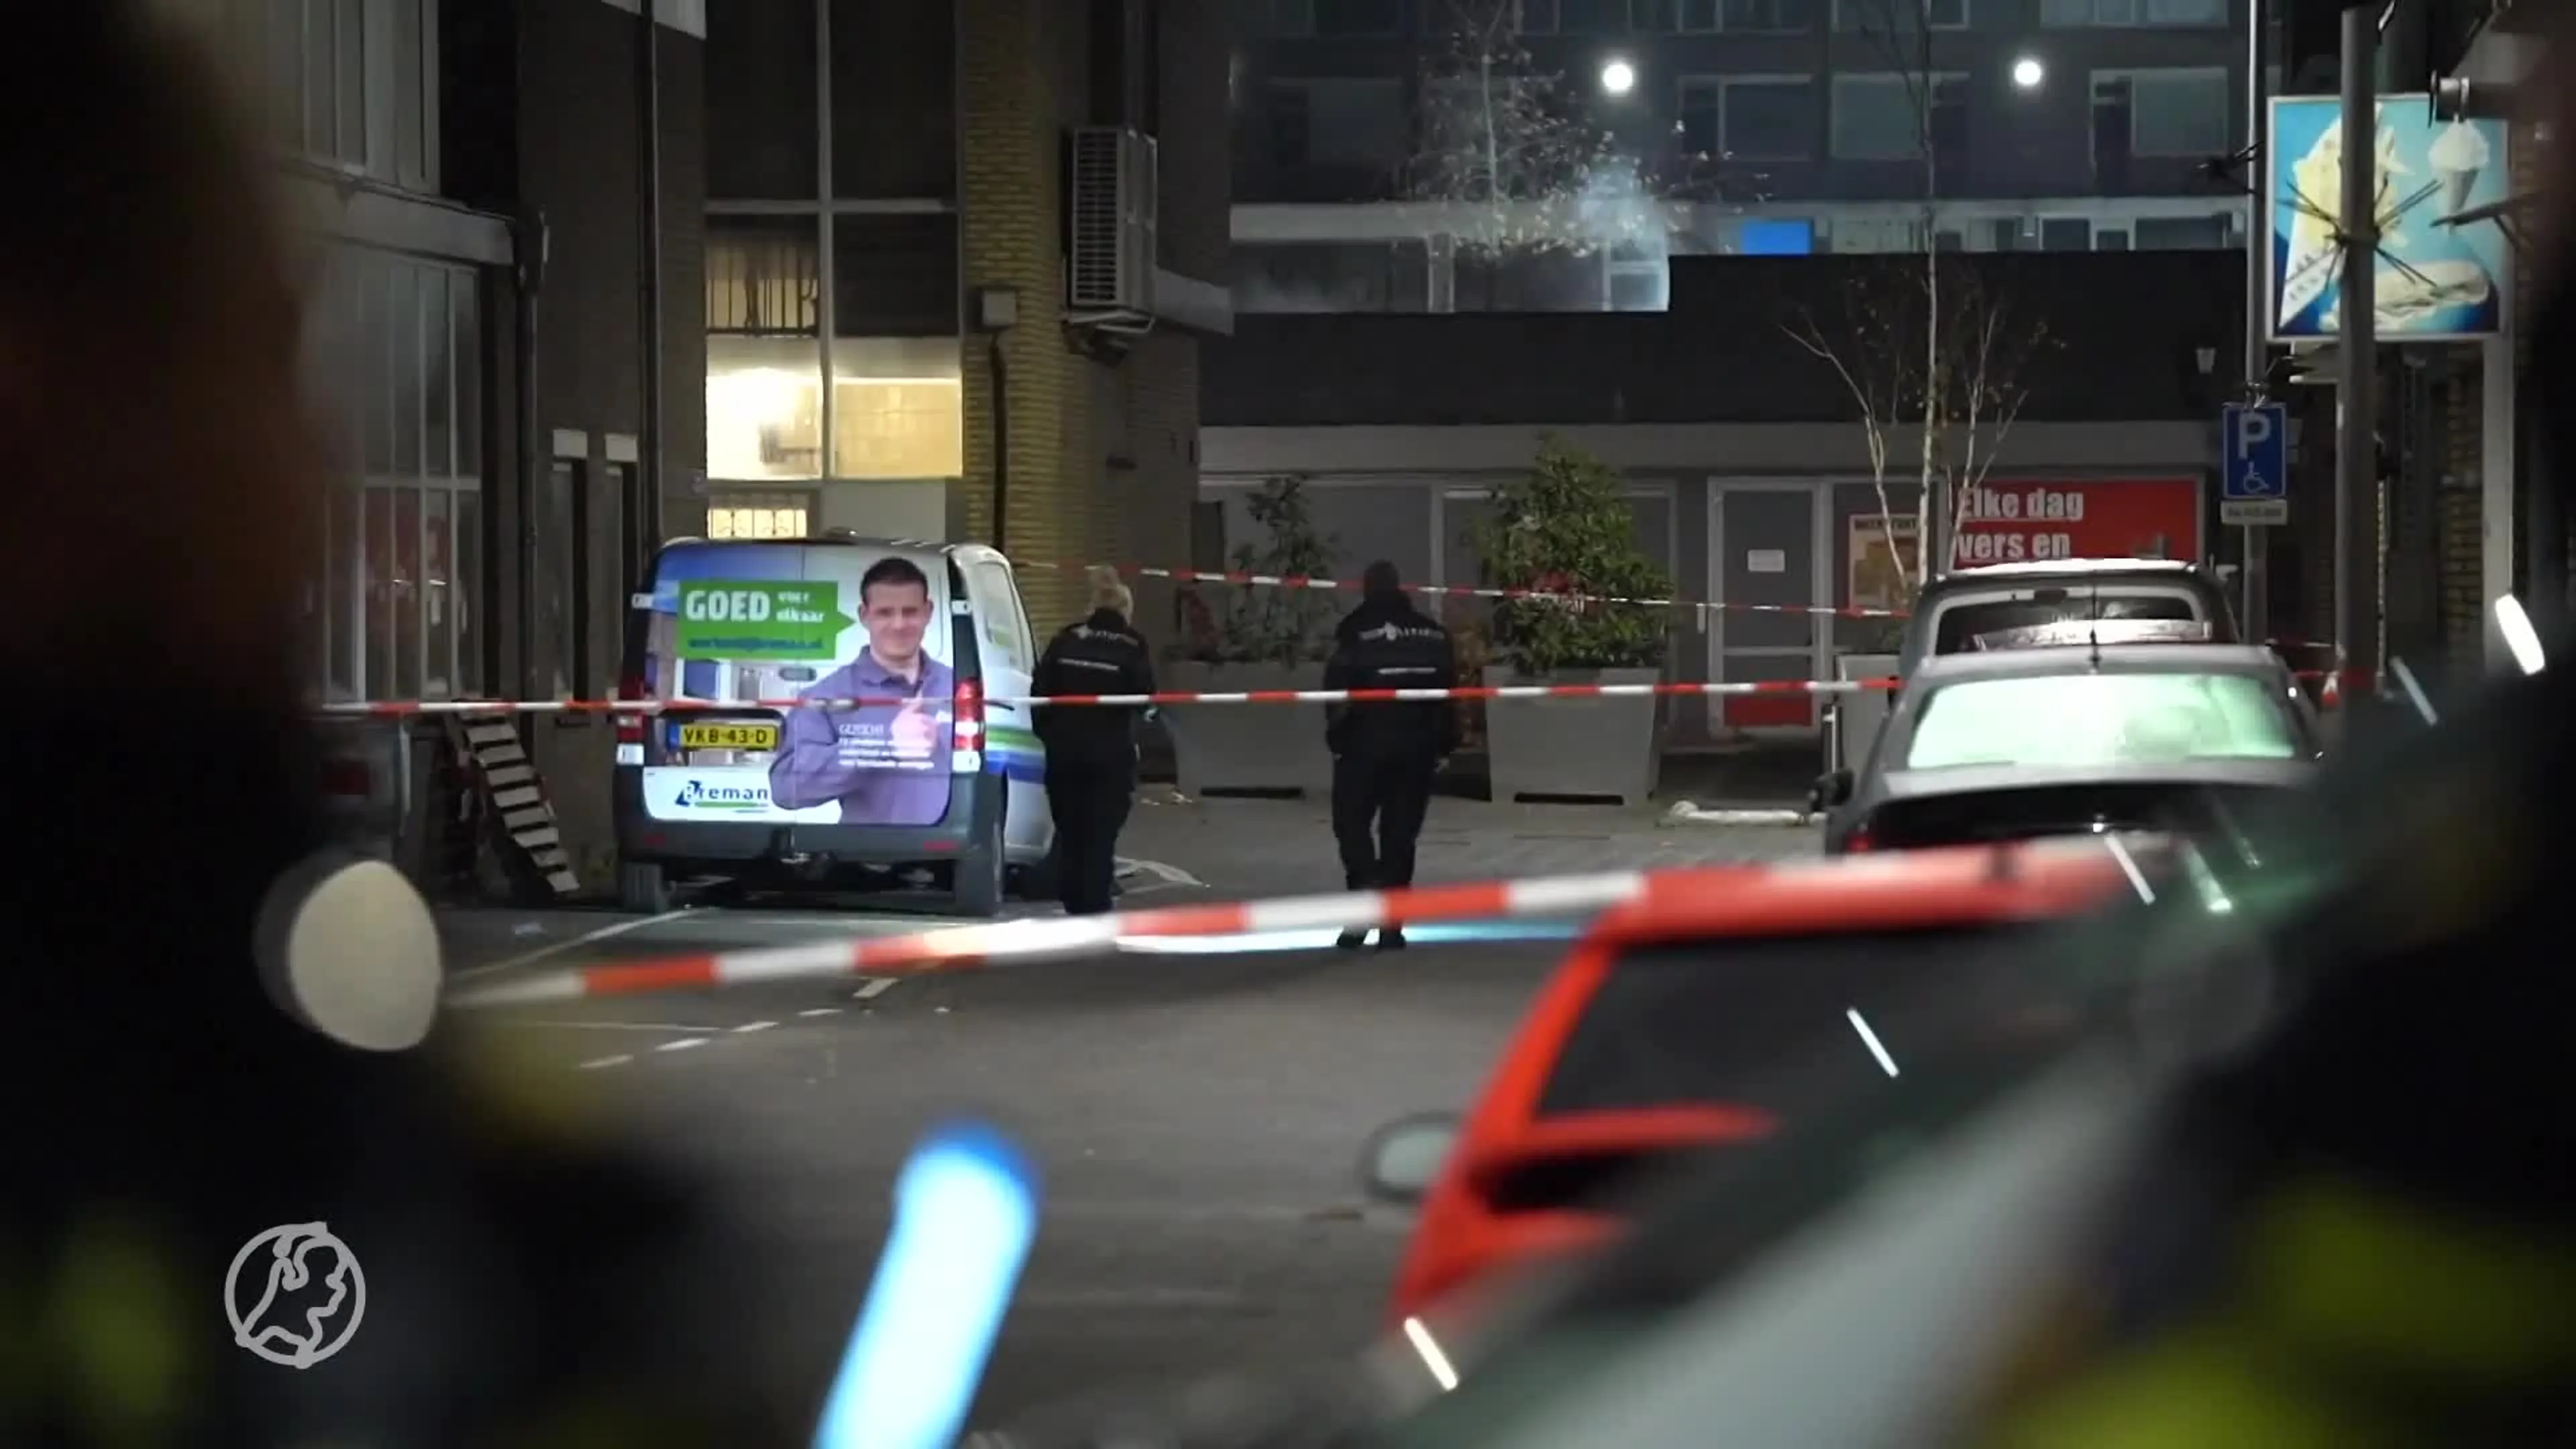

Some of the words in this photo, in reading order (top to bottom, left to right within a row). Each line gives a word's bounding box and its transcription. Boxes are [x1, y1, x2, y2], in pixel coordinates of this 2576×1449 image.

[2238, 412, 2271, 460] P
[1957, 488, 2019, 519] Elke
[2027, 488, 2084, 522] dag
[1955, 533, 2025, 559] vers
[2031, 533, 2072, 559] en
[686, 590, 771, 622] GOED
